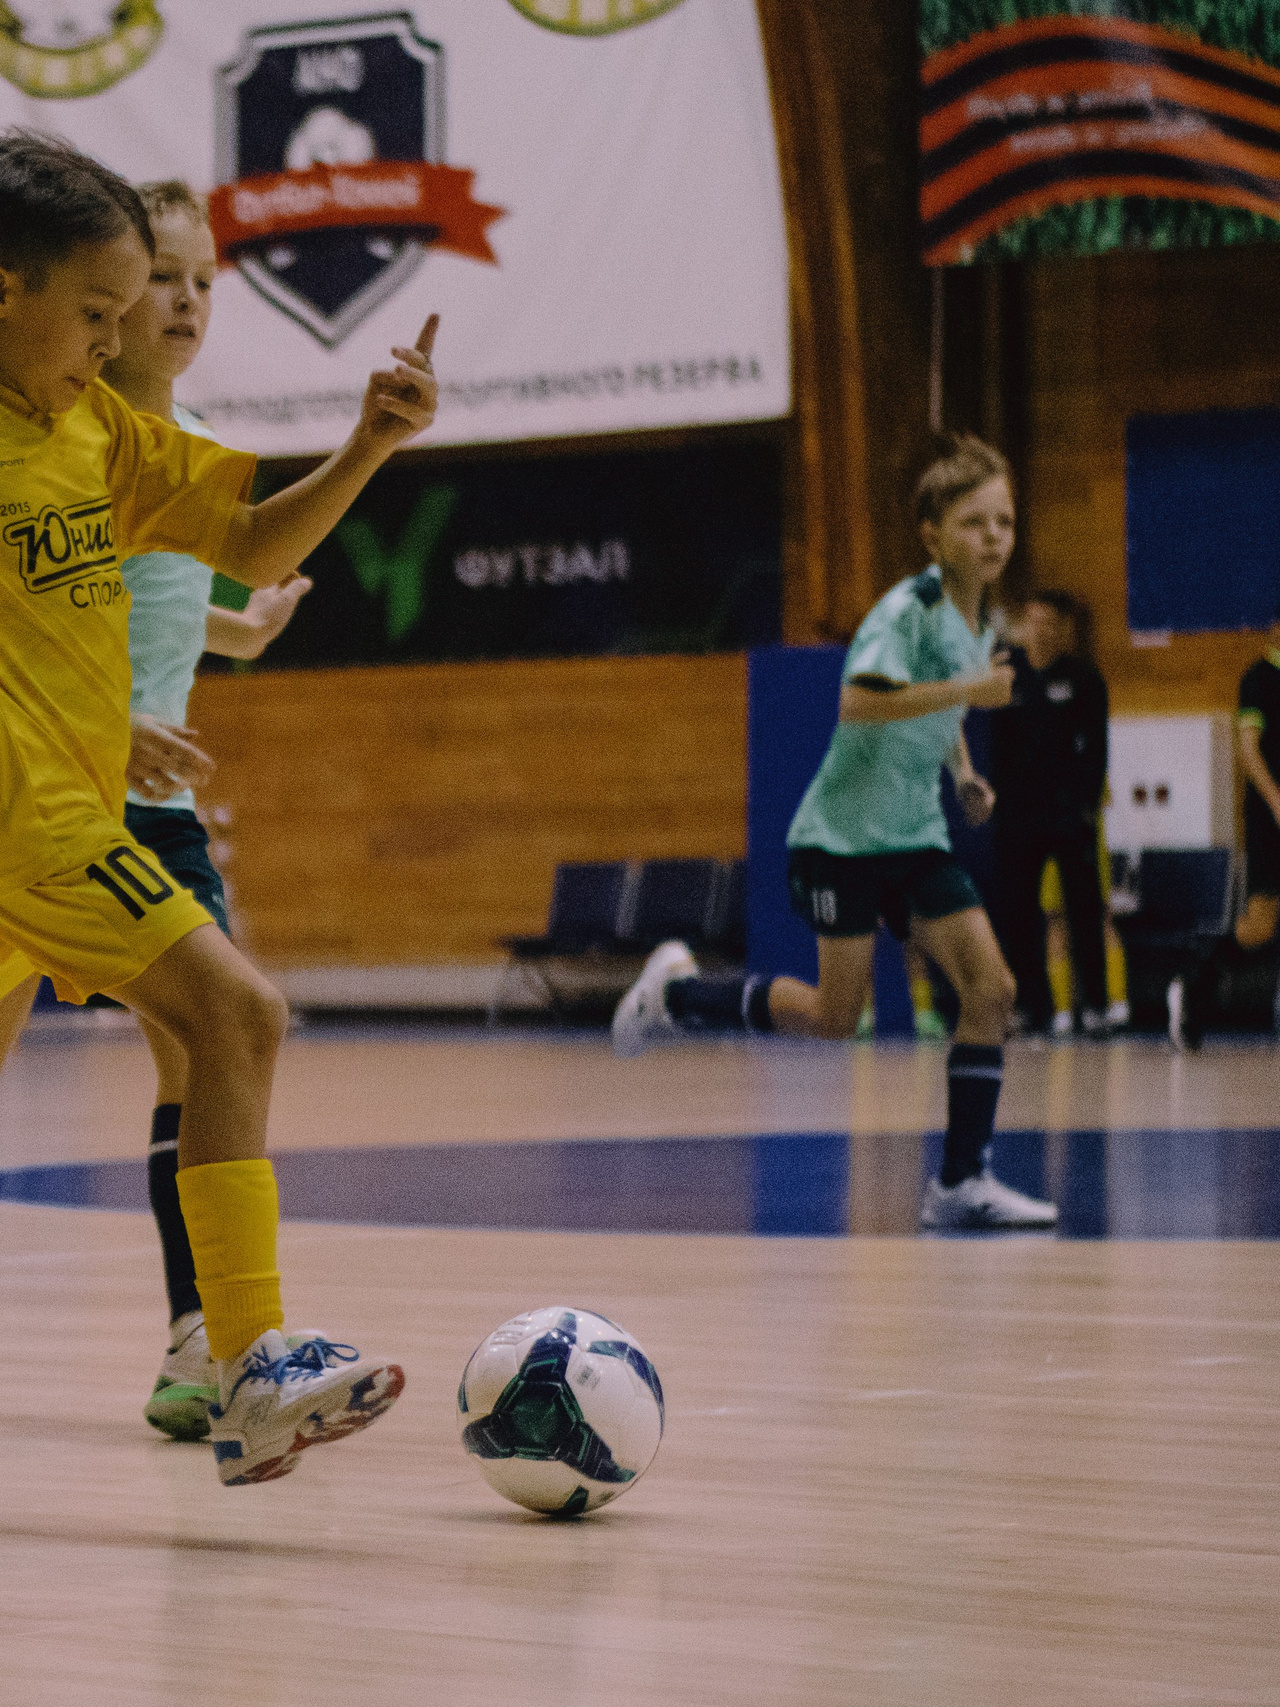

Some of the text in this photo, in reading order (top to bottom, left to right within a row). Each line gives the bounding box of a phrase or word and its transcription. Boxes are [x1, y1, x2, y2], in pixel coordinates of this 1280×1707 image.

[439, 366, 626, 407] ПОРТИВНОГО
[632, 355, 763, 392] РЕЗЕРВА
[0, 500, 31, 517] 2015
[85, 845, 174, 921] 10
